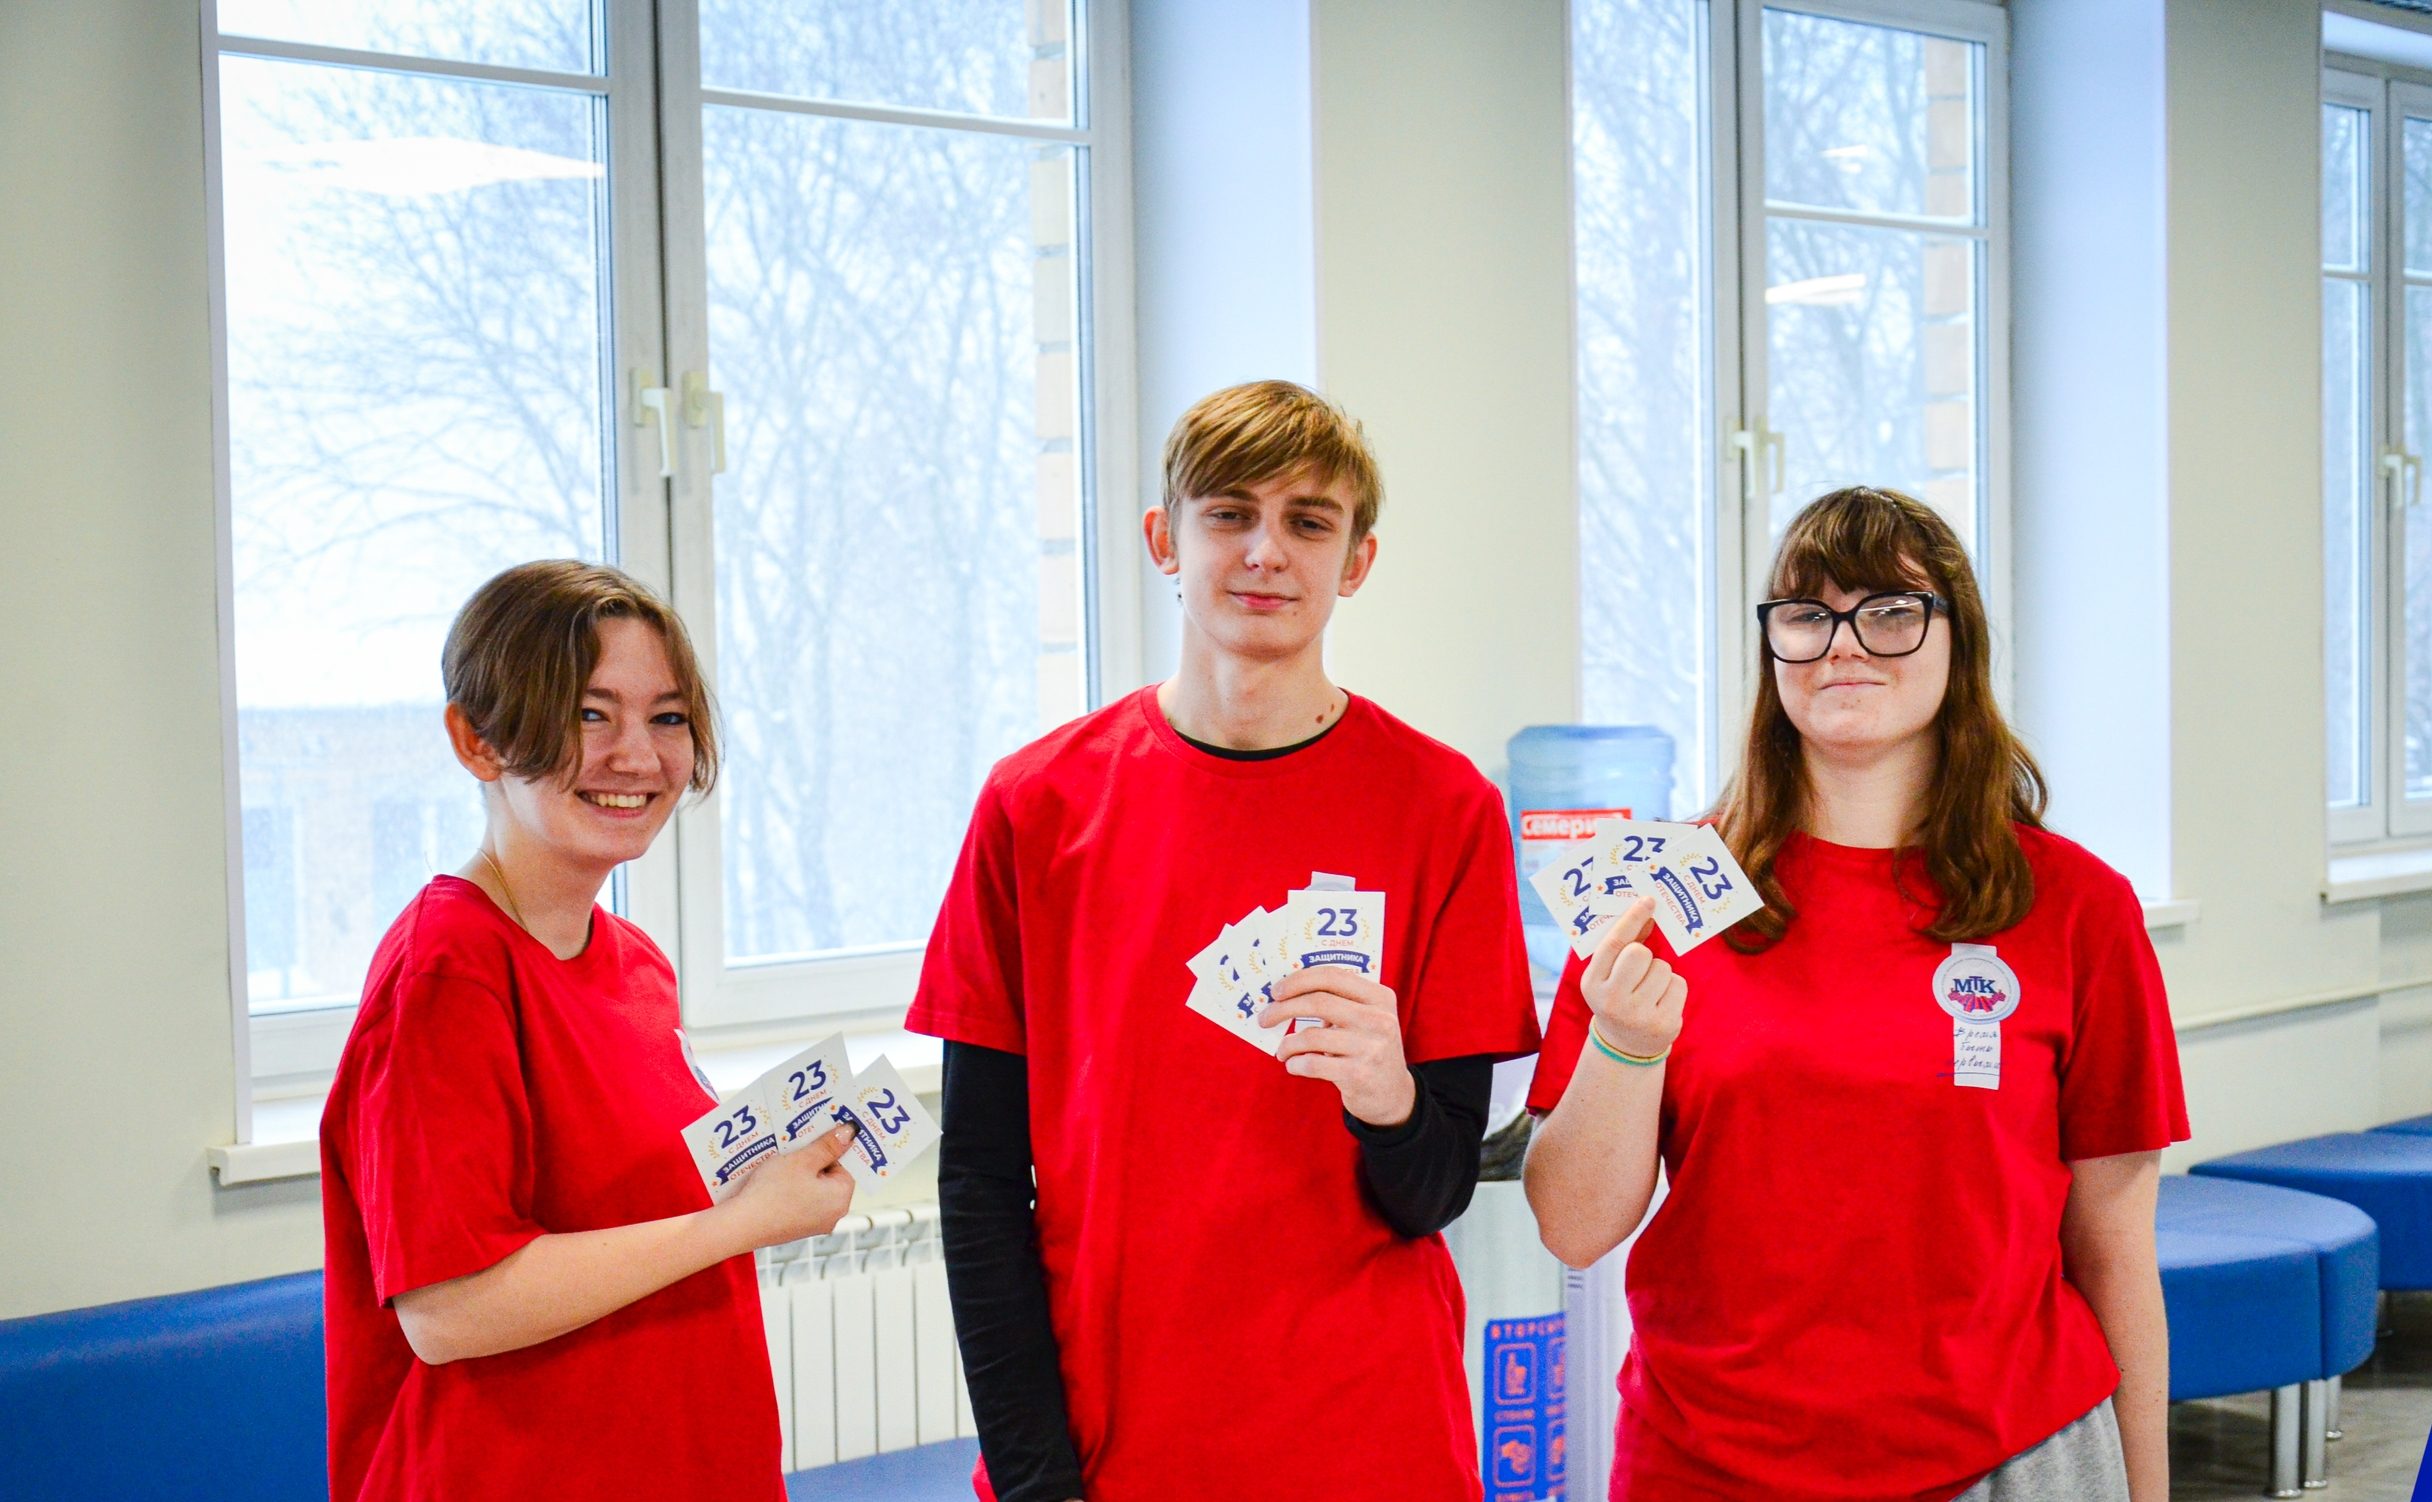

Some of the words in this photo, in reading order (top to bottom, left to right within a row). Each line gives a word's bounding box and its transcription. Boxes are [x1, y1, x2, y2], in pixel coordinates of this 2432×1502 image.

[1663, 873, 1700, 923] ЗАЩИТНИКА
[1690, 856, 1734, 900] 23
[1317, 908, 1358, 937] 23
[1655, 881, 1687, 926] ОТЕЧЕСТВА
[1308, 953, 1364, 964] ЗАЩИТНИКА
[1953, 975, 1996, 993] МТК
[788, 1059, 827, 1101] 23
[714, 1105, 757, 1149] 23
[866, 1088, 911, 1135] 23
[722, 1136, 776, 1174] ЗАЩИТНИКА
[735, 1131, 760, 1150] ДНЕМ
[730, 1149, 777, 1181] ОТЕЧЕСТВА
